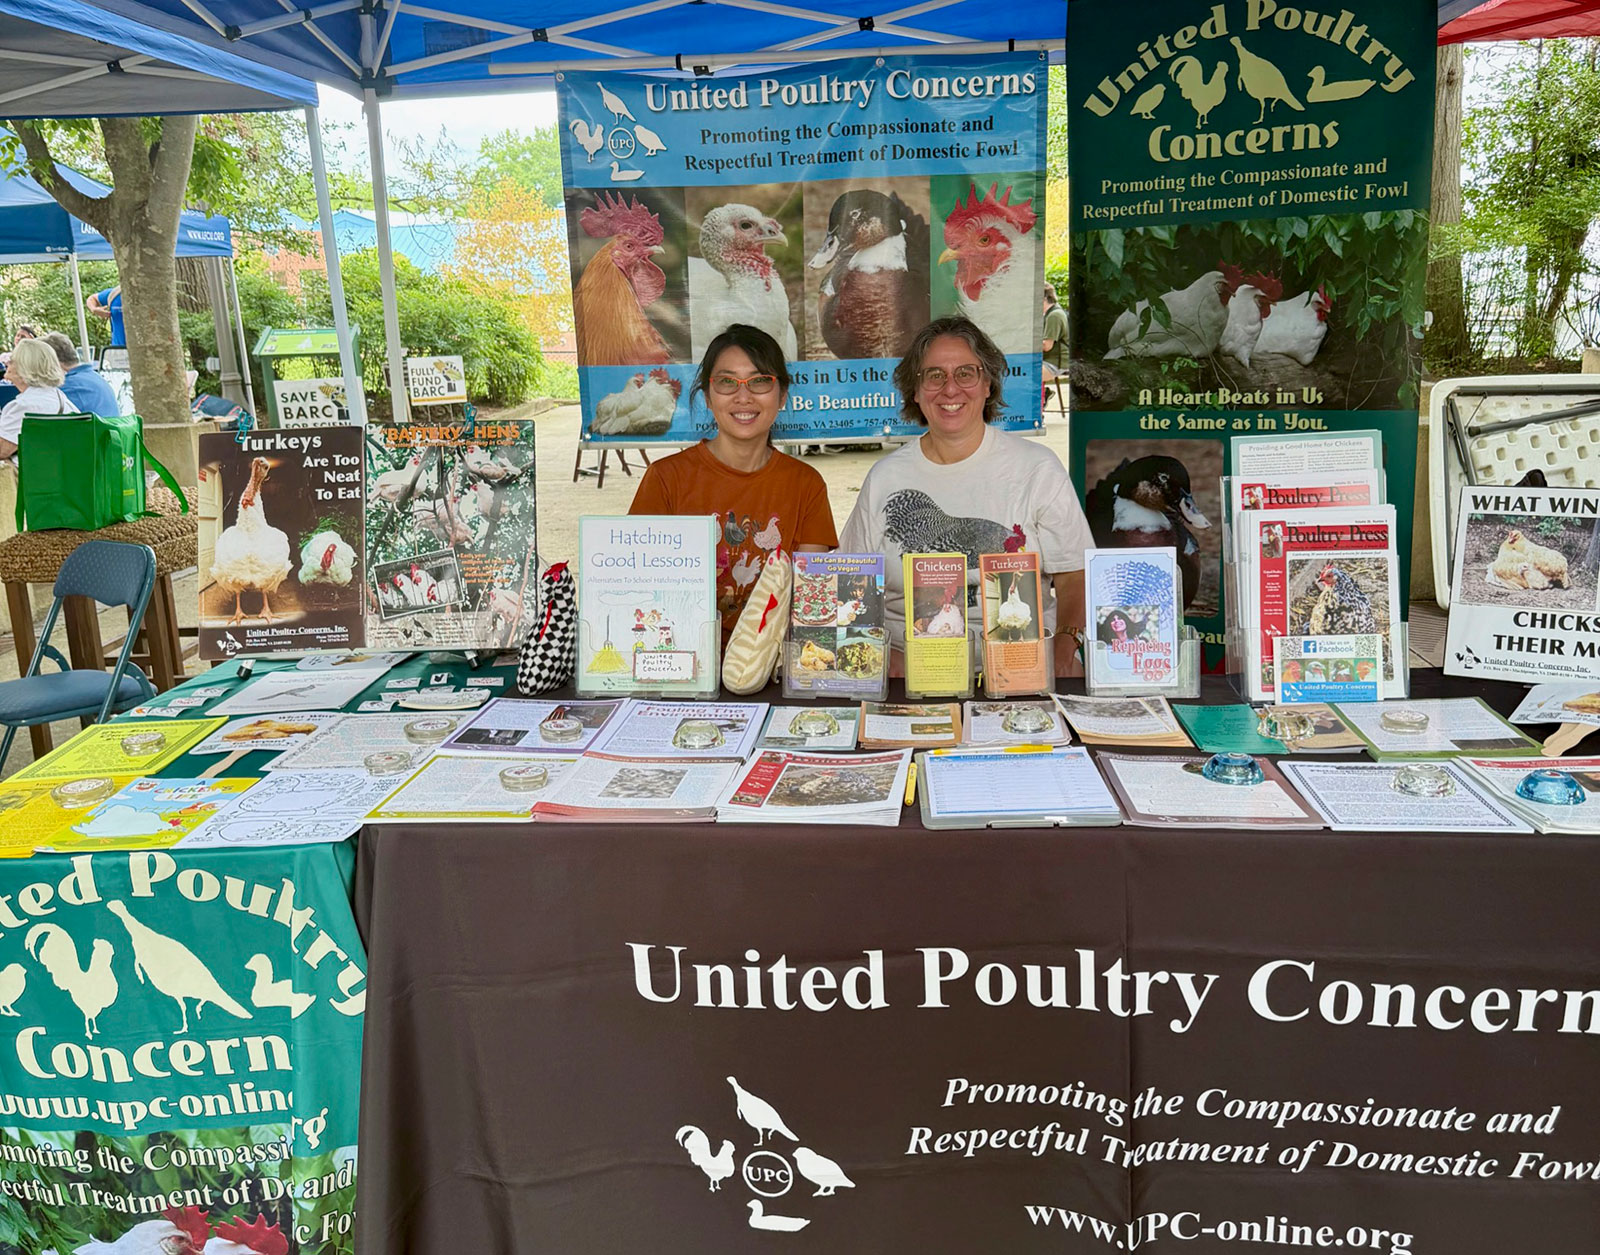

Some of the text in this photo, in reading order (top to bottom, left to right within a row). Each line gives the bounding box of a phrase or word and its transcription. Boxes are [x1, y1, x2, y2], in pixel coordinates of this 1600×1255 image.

[1083, 0, 1416, 118] United Poultry
[643, 69, 1037, 113] United Poultry Concerns
[700, 115, 994, 146] Promoting the Compassionate and
[611, 138, 634, 150] UPC
[1148, 120, 1340, 163] Concerns
[685, 140, 1018, 174] Respectful Treatment of Domestic Fowl
[1101, 157, 1388, 195] Promoting the Compassionate and
[1082, 181, 1409, 221] Respectful Treatment of Domestic Fowl
[410, 367, 436, 378] FULLY
[411, 376, 442, 387] FUND
[814, 368, 830, 385] in
[836, 368, 858, 384] Us
[862, 366, 889, 382] the
[280, 391, 318, 404] SAVE
[412, 386, 445, 398] BARC
[792, 391, 897, 412] Be Beautiful
[1137, 386, 1325, 406] A Heart Beats in Us
[284, 405, 333, 421] BARC
[1139, 412, 1328, 431] the Same as in You.
[474, 424, 520, 439] HENS
[813, 420, 826, 429] VA
[829, 418, 855, 428] 23405
[239, 434, 323, 454] Turkeys
[1248, 444, 1279, 453] Providing
[1285, 441, 1303, 449] Good
[1304, 441, 1323, 449] Home
[303, 454, 360, 468] Are Too
[324, 470, 362, 484] Neat
[315, 486, 362, 501] To Eat
[1266, 486, 1370, 508] Poultry Press
[1471, 494, 1542, 513] WHAT
[610, 527, 683, 550] Hatching
[1287, 524, 1390, 548] Poultry Press
[591, 552, 702, 570] Good Lessons
[811, 557, 877, 566] Life Can Be Beautiful
[837, 565, 860, 574] Vegan!
[915, 560, 963, 573] Chickens
[990, 560, 1029, 571] Turkeys
[587, 576, 705, 586] Alternatives To School Hatching Projects
[246, 629, 270, 638] United
[271, 628, 297, 637] Poultry
[334, 625, 349, 633] Inc.
[1513, 611, 1600, 633] CHICKS
[1110, 635, 1171, 656] Replacing
[1318, 645, 1354, 653] Facebook
[1493, 634, 1565, 656] THEIR
[642, 660, 672, 668] Poultry
[1132, 652, 1171, 682] Eggs
[1484, 656, 1592, 674] United Poultry Concerns, Inc.
[645, 706, 744, 714] Fouling The
[128, 852, 367, 1017] Poultry
[625, 942, 891, 1012] United
[914, 947, 1220, 1034] Poultry
[15, 1026, 294, 1083] Concern
[941, 1077, 1562, 1135] Promoting the Compassionate and
[904, 1122, 1600, 1181] Respectful Treatment of Domestic Fowl
[97, 1143, 135, 1174] the
[302, 1159, 354, 1201] and
[746, 1165, 790, 1184] UPC
[69, 1181, 220, 1216] Treatment
[223, 1180, 251, 1206] of
[1024, 1205, 1414, 1255] www.UPC-online.org
